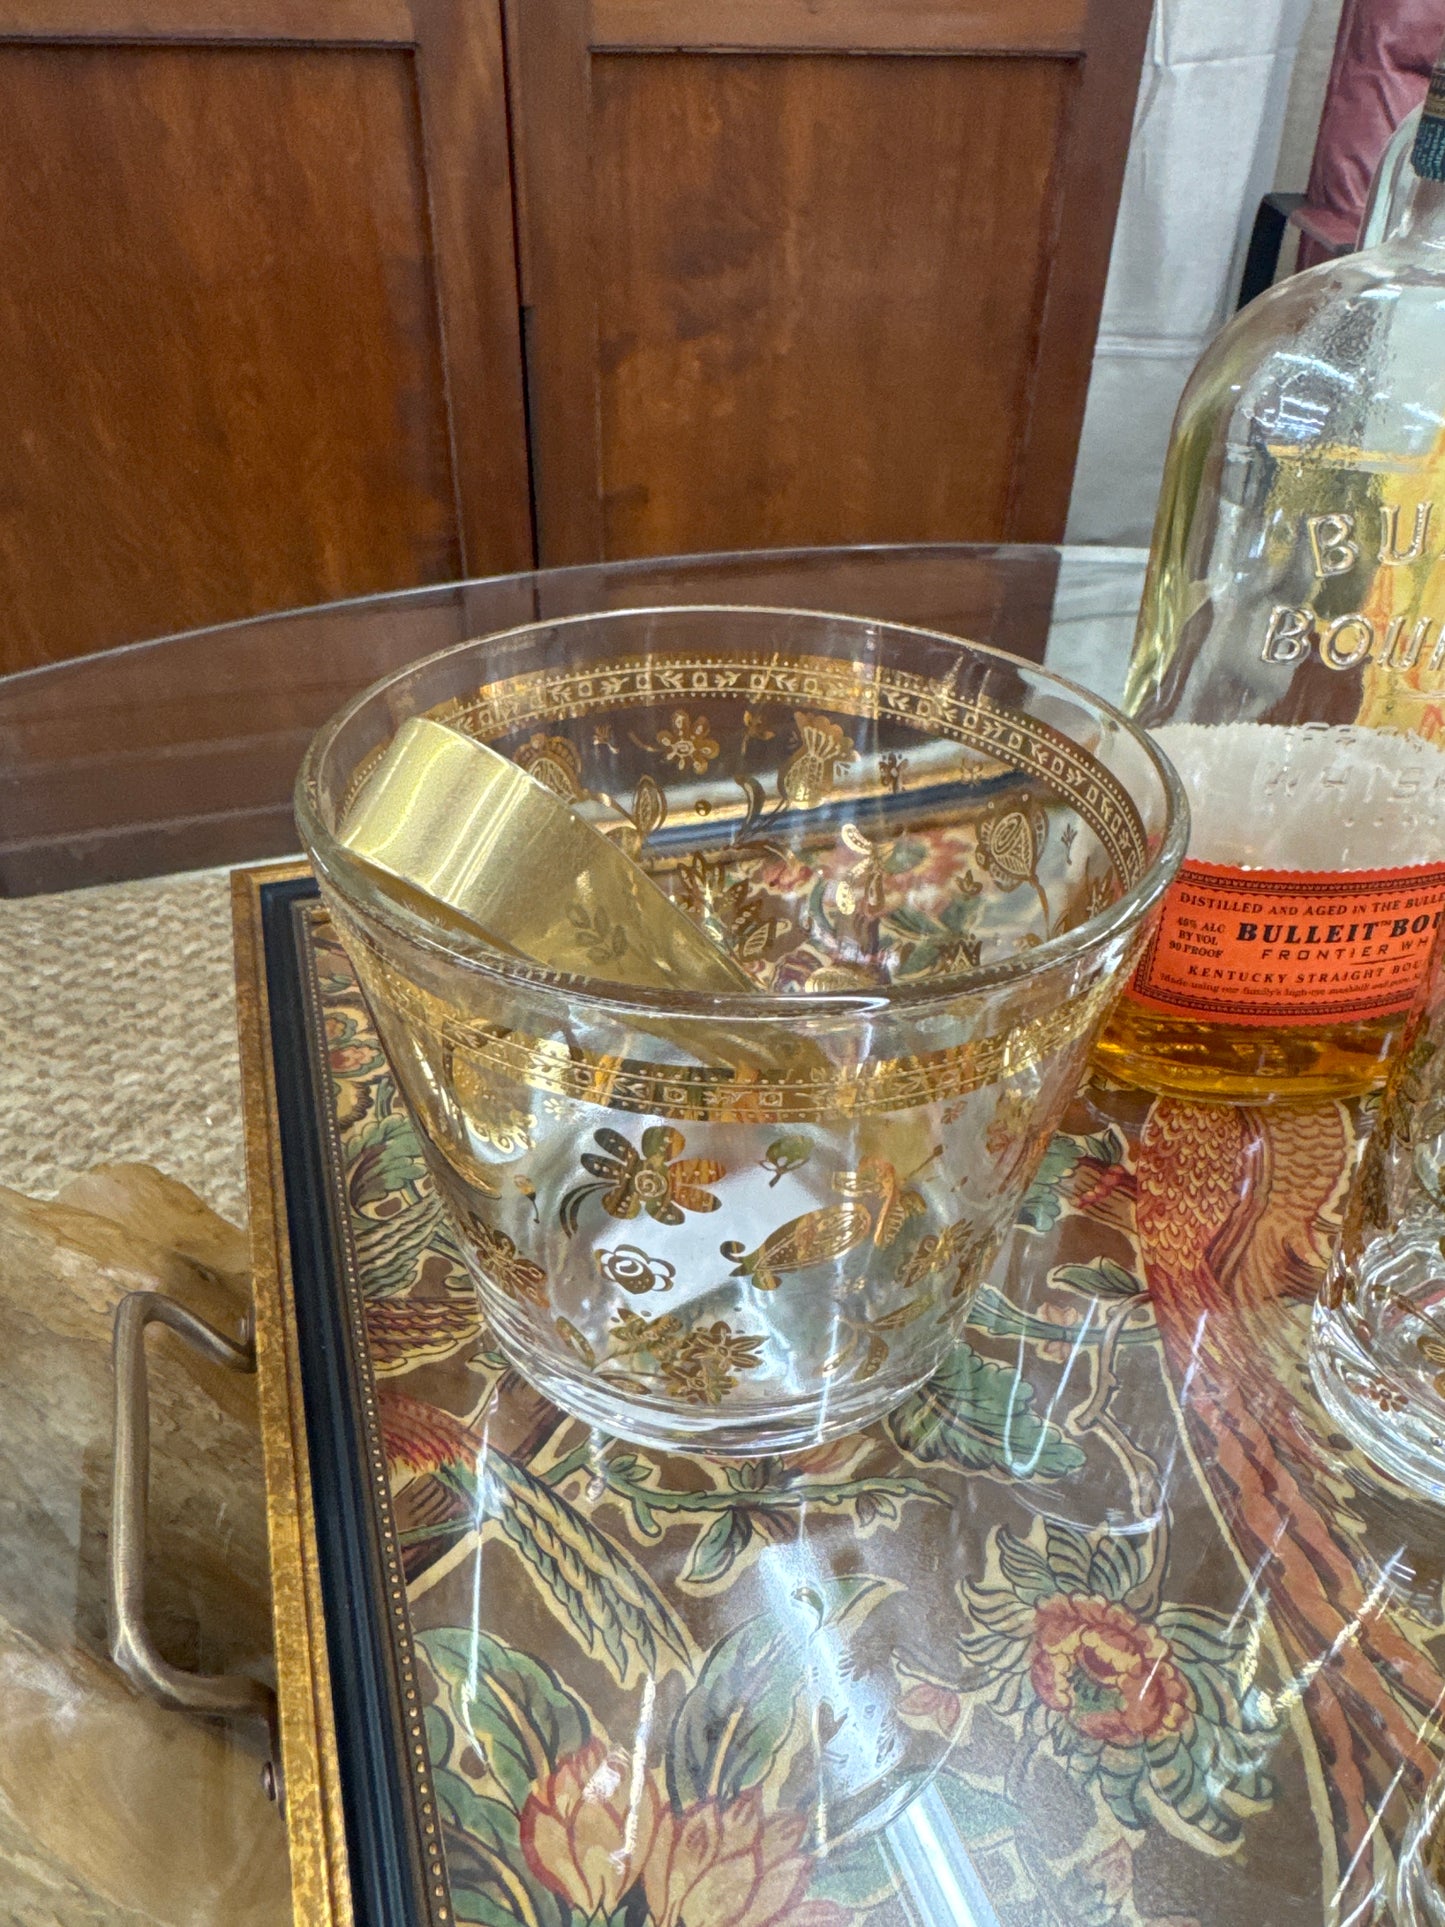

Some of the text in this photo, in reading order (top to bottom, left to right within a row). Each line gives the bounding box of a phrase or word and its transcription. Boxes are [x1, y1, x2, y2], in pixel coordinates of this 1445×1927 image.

[1307, 501, 1445, 577] BU
[1180, 892, 1262, 913] DISTILLED
[1268, 906, 1298, 915] AND
[1303, 904, 1347, 915] AGED
[1352, 904, 1366, 914] IN
[1372, 900, 1400, 912] THE
[1201, 922, 1226, 933] ALC
[1178, 929, 1218, 946] BY VOL
[1169, 940, 1224, 958] 90 PROOF
[1261, 944, 1389, 960] FRONTIER
[1188, 965, 1287, 983] KENTUCKY
[1295, 967, 1384, 983] STRAIGHT
